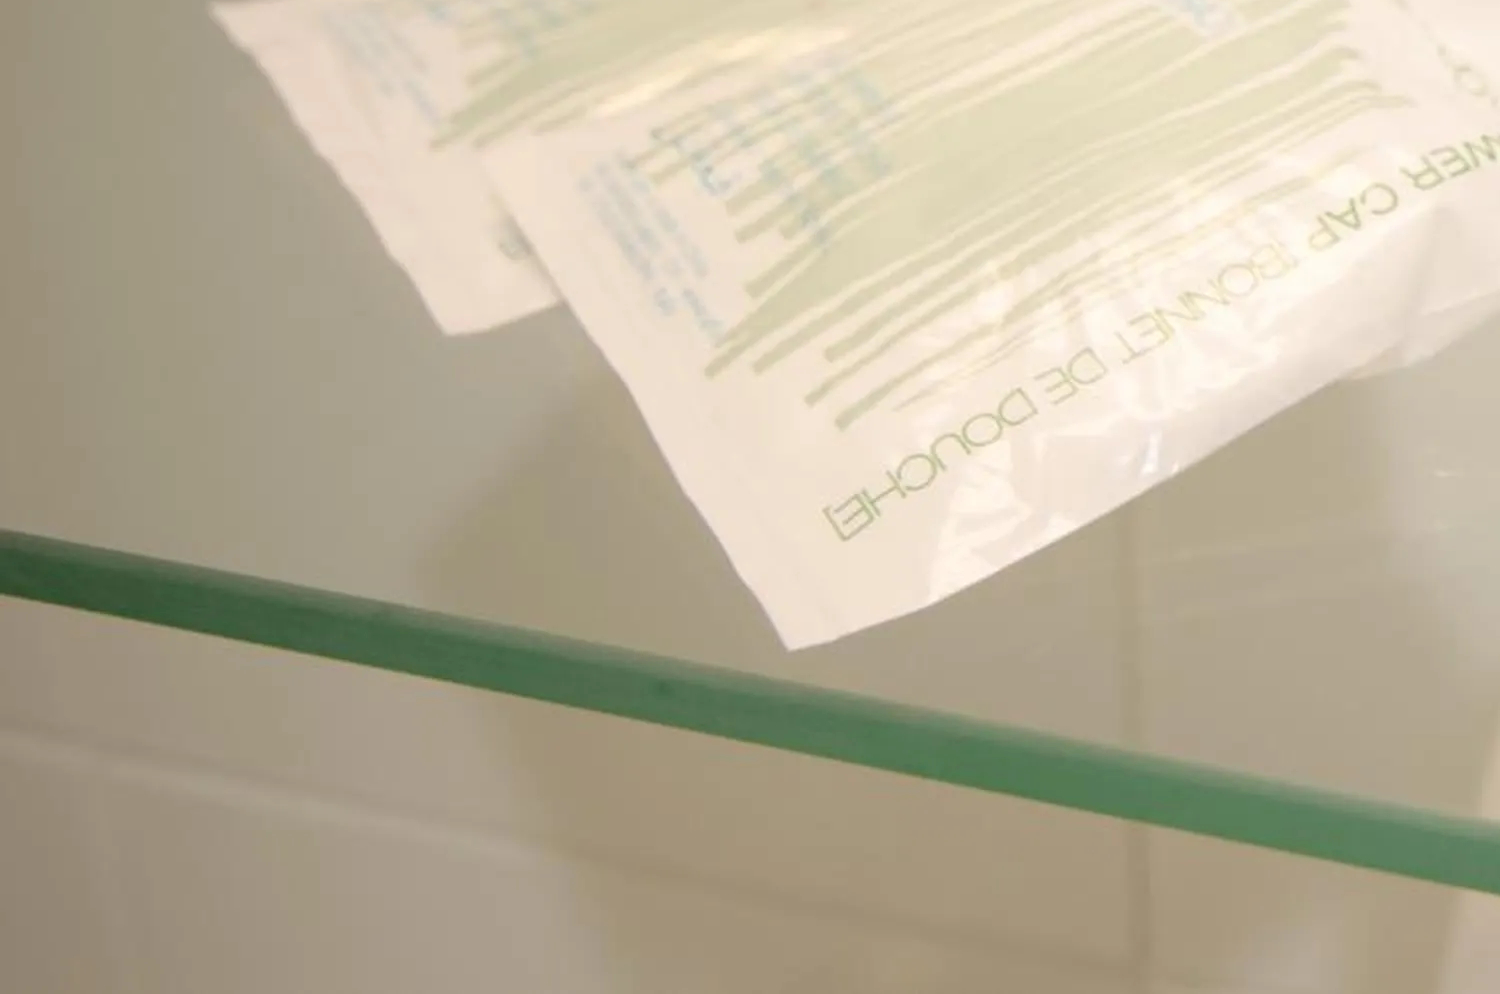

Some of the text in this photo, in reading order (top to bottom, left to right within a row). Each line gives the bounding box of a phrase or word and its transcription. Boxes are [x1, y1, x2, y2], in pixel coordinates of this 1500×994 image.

[1307, 179, 1401, 257] CAP
[1049, 345, 1110, 409] DE
[821, 386, 1040, 543] DOUCHE]
